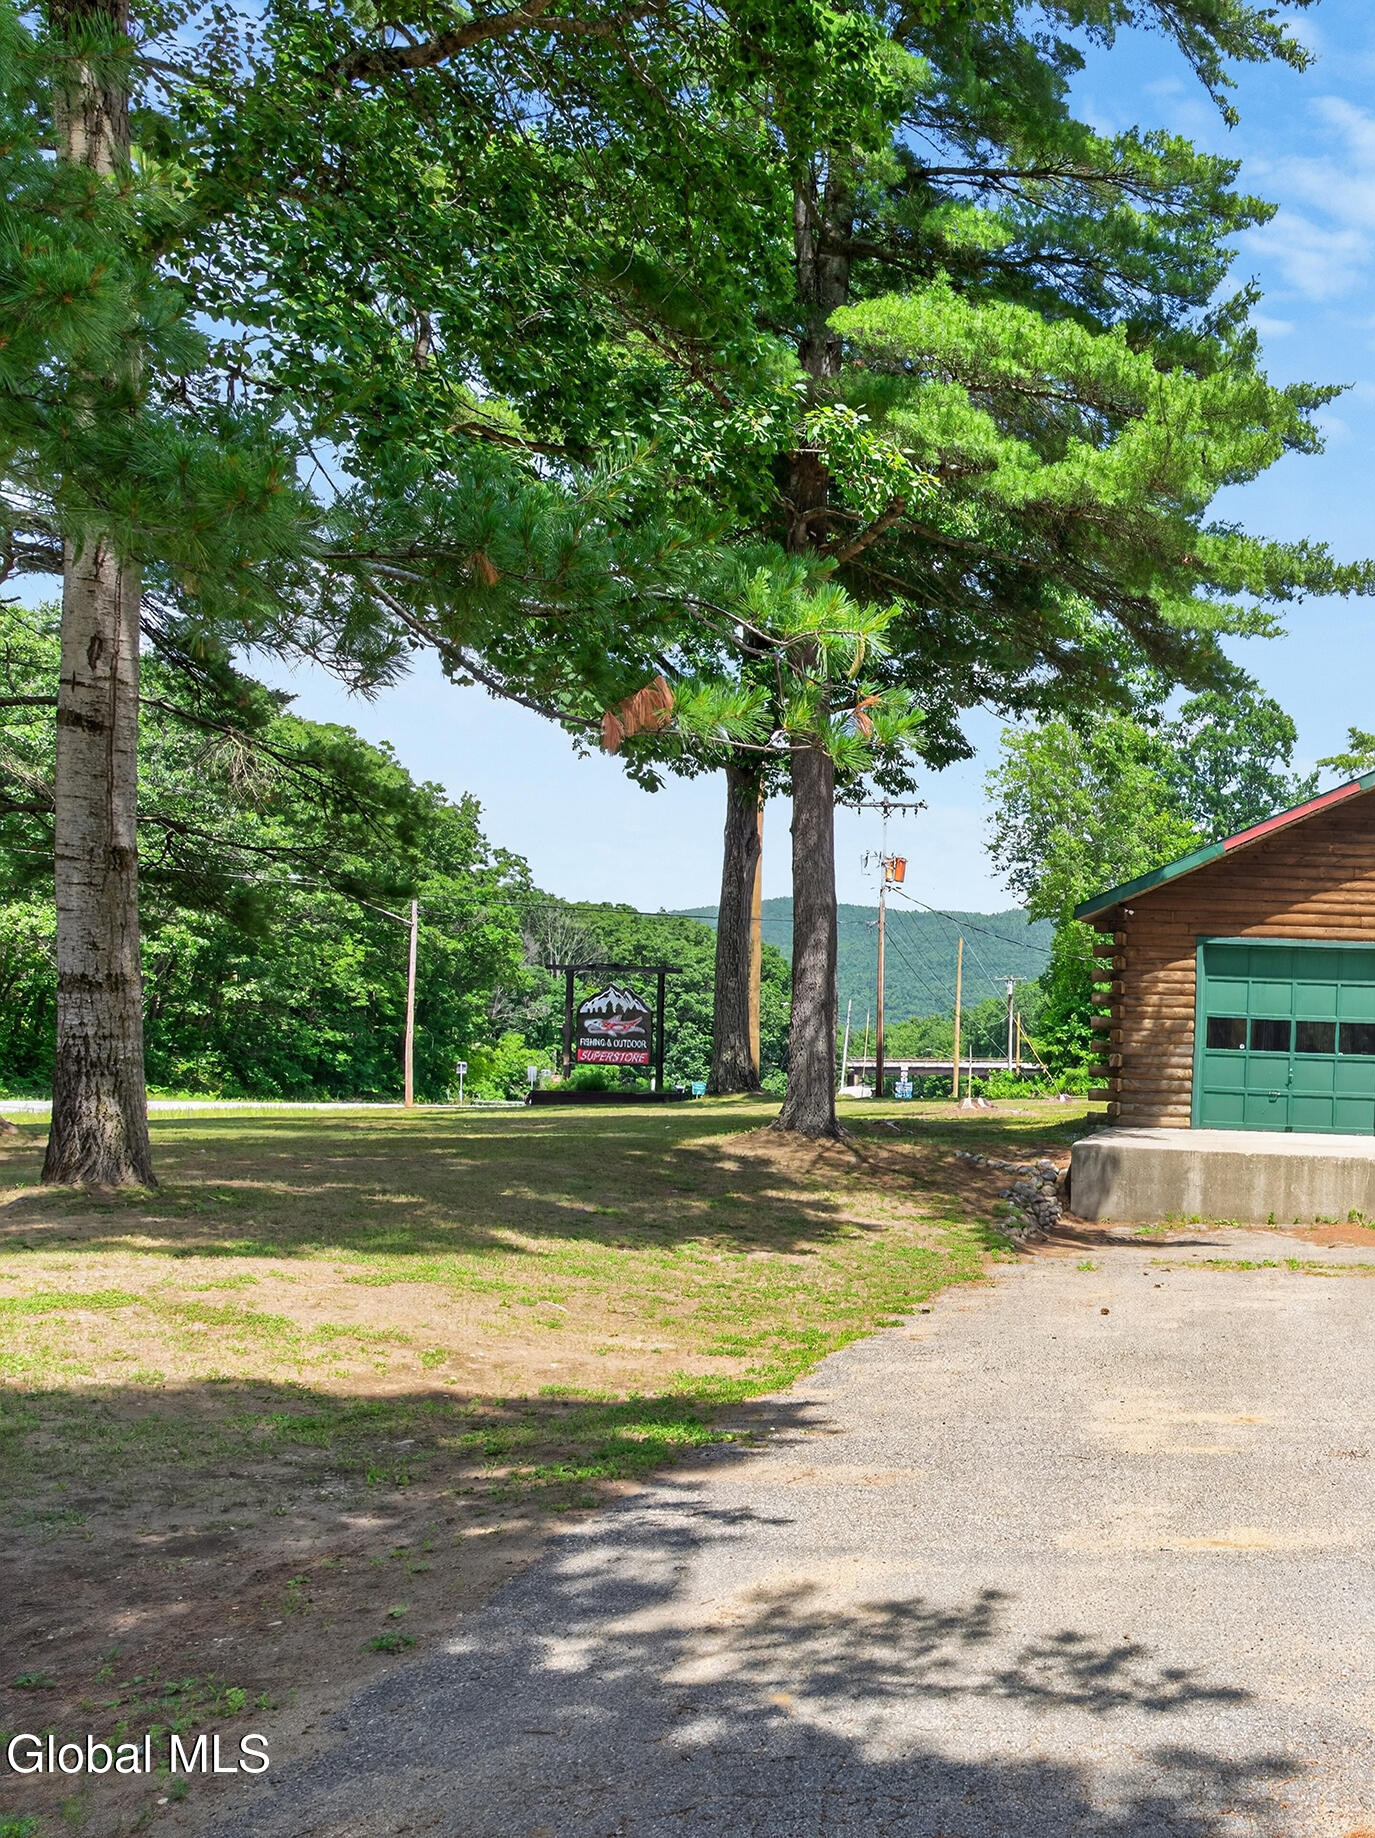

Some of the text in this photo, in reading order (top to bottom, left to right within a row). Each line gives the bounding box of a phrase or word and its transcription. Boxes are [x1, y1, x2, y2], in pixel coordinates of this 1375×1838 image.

[579, 1037, 648, 1049] FISHING & OUTDOOR
[580, 1049, 647, 1063] SUPERSTORE
